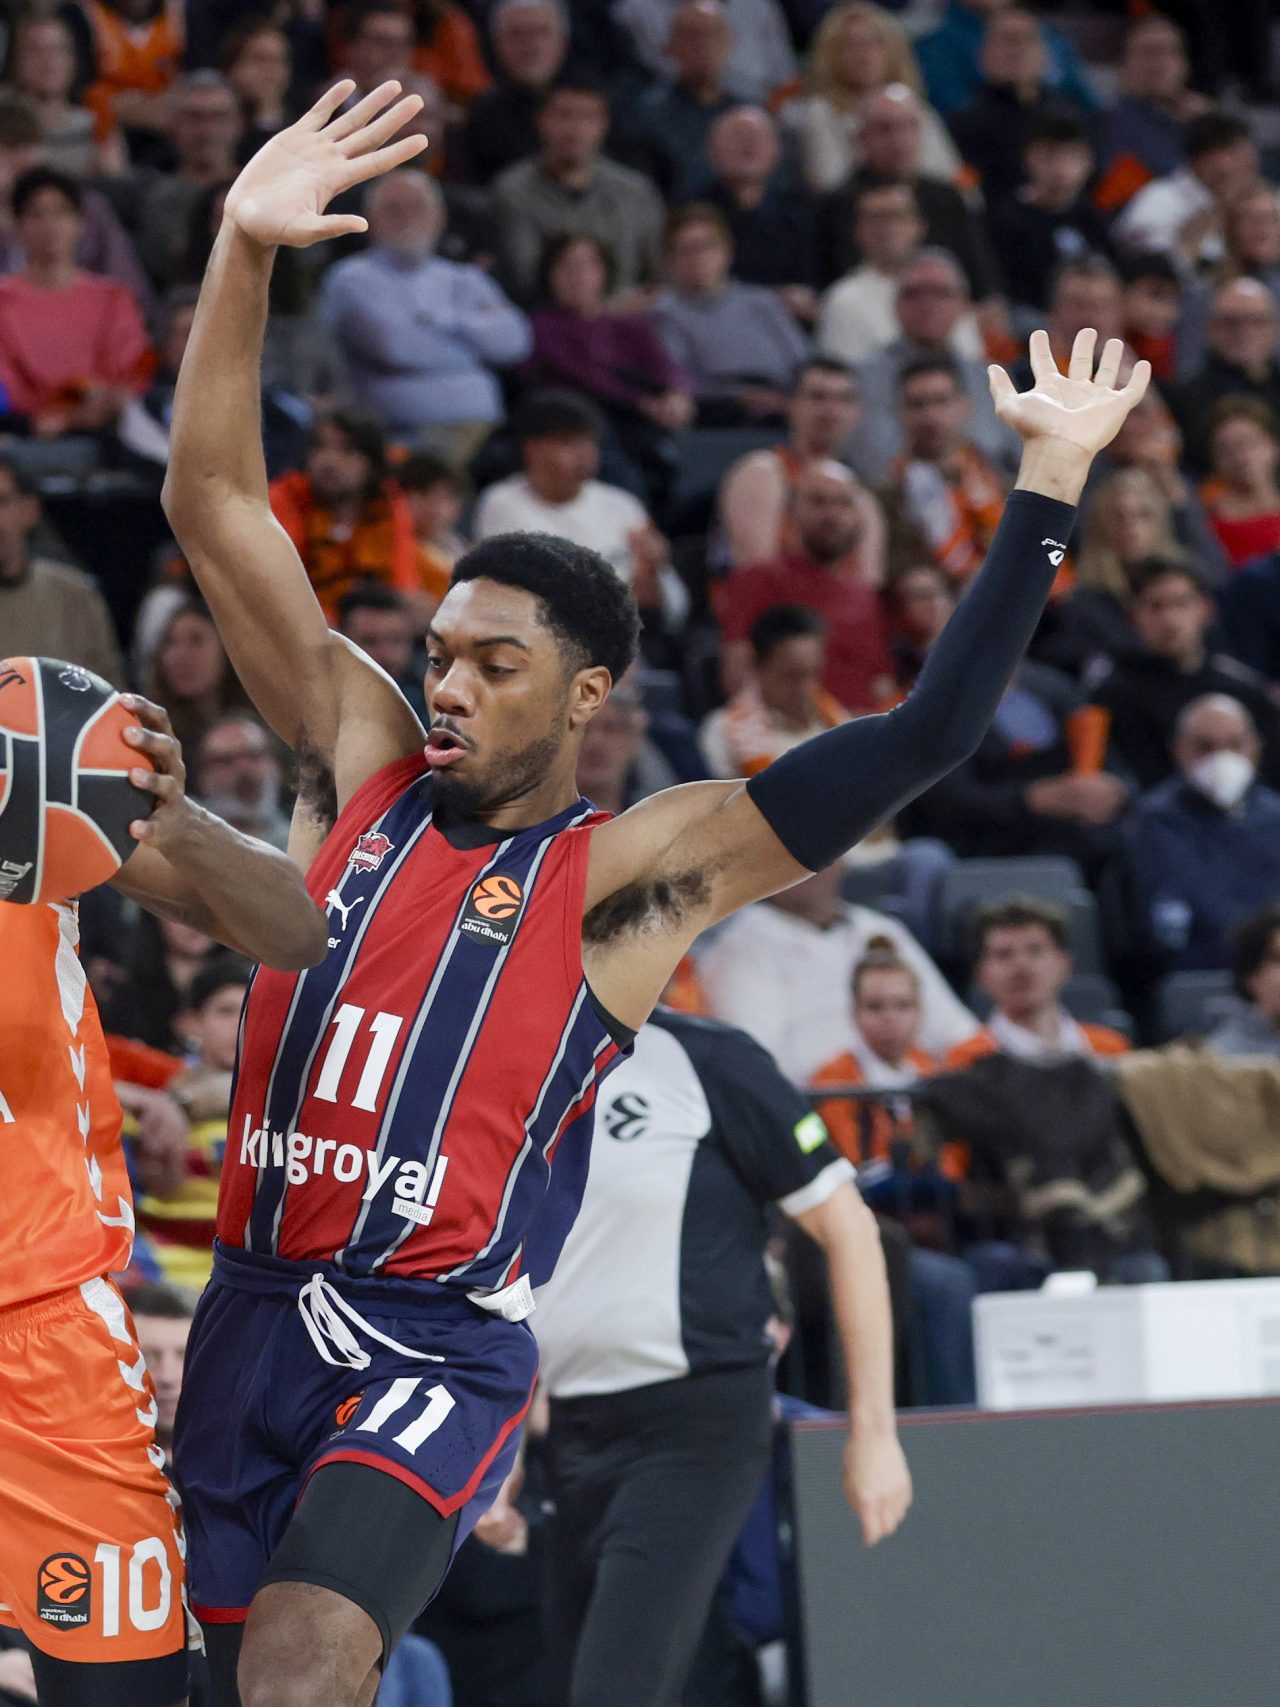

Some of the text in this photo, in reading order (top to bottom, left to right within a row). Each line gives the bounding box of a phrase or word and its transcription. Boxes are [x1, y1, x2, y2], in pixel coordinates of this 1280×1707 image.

[461, 922, 509, 943] abu dhabi
[313, 1003, 404, 1113] 11
[239, 1113, 449, 1207] kingroyal
[355, 1377, 457, 1456] 11
[40, 1612, 88, 1623] abu dhabi
[94, 1536, 172, 1638] 10
